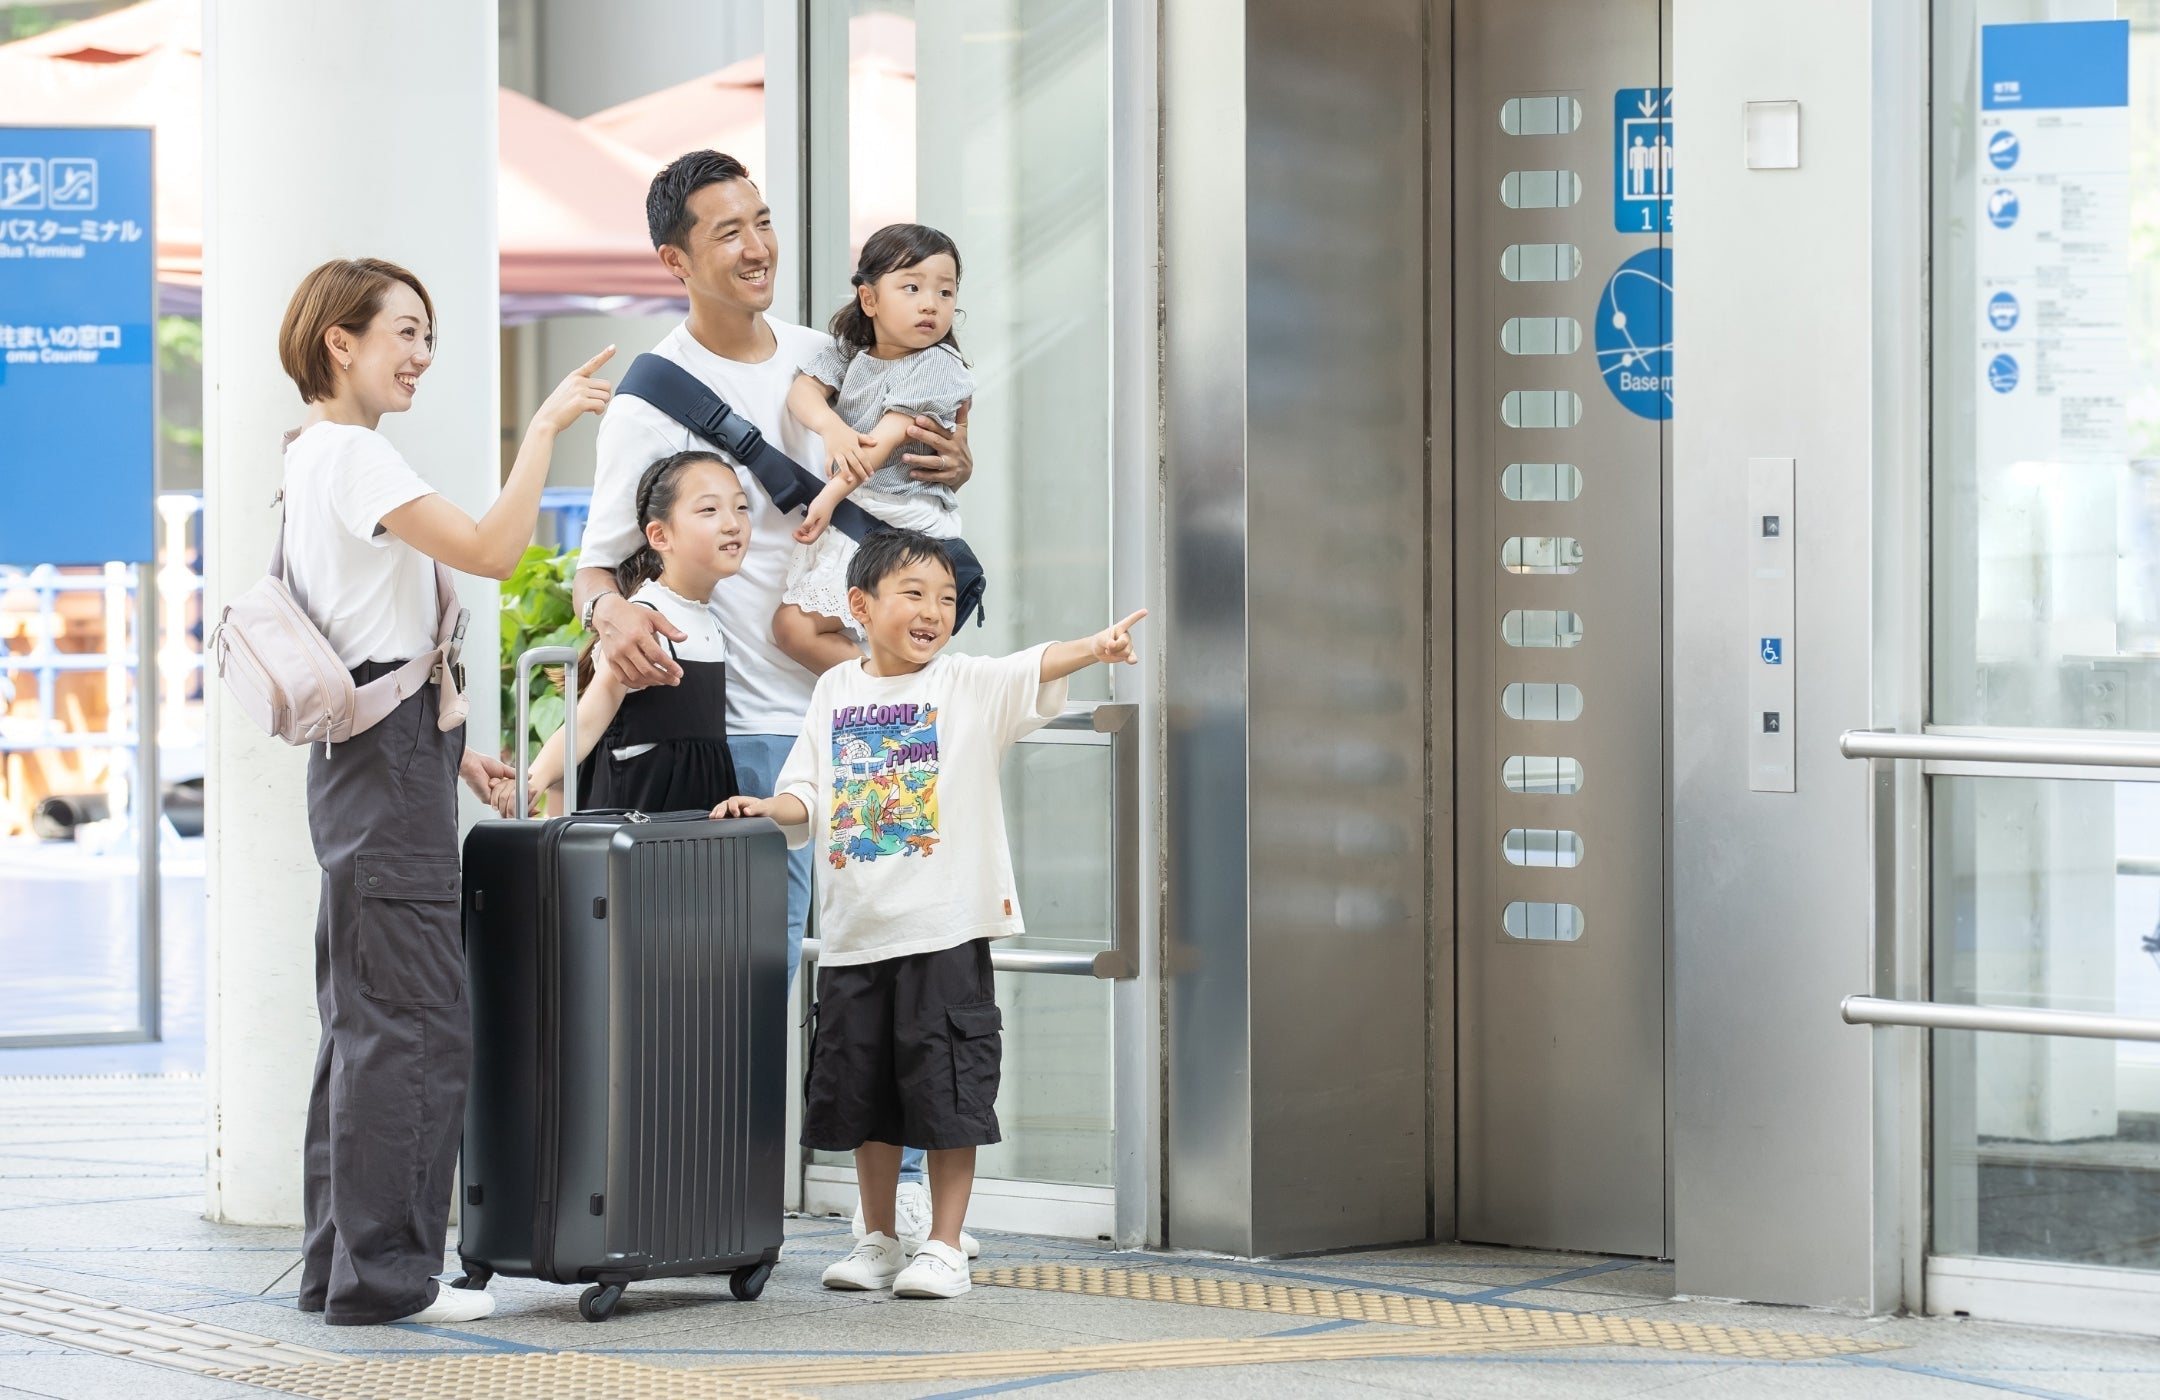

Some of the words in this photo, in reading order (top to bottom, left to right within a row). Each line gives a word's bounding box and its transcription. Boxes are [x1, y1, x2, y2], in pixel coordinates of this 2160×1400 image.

[0, 219, 142, 242] バスターミナル
[0, 243, 24, 258] Bus
[26, 243, 85, 258] Terminal
[41, 348, 99, 363] Counter
[832, 704, 918, 730] WELCOME
[886, 741, 938, 767] FPDM
